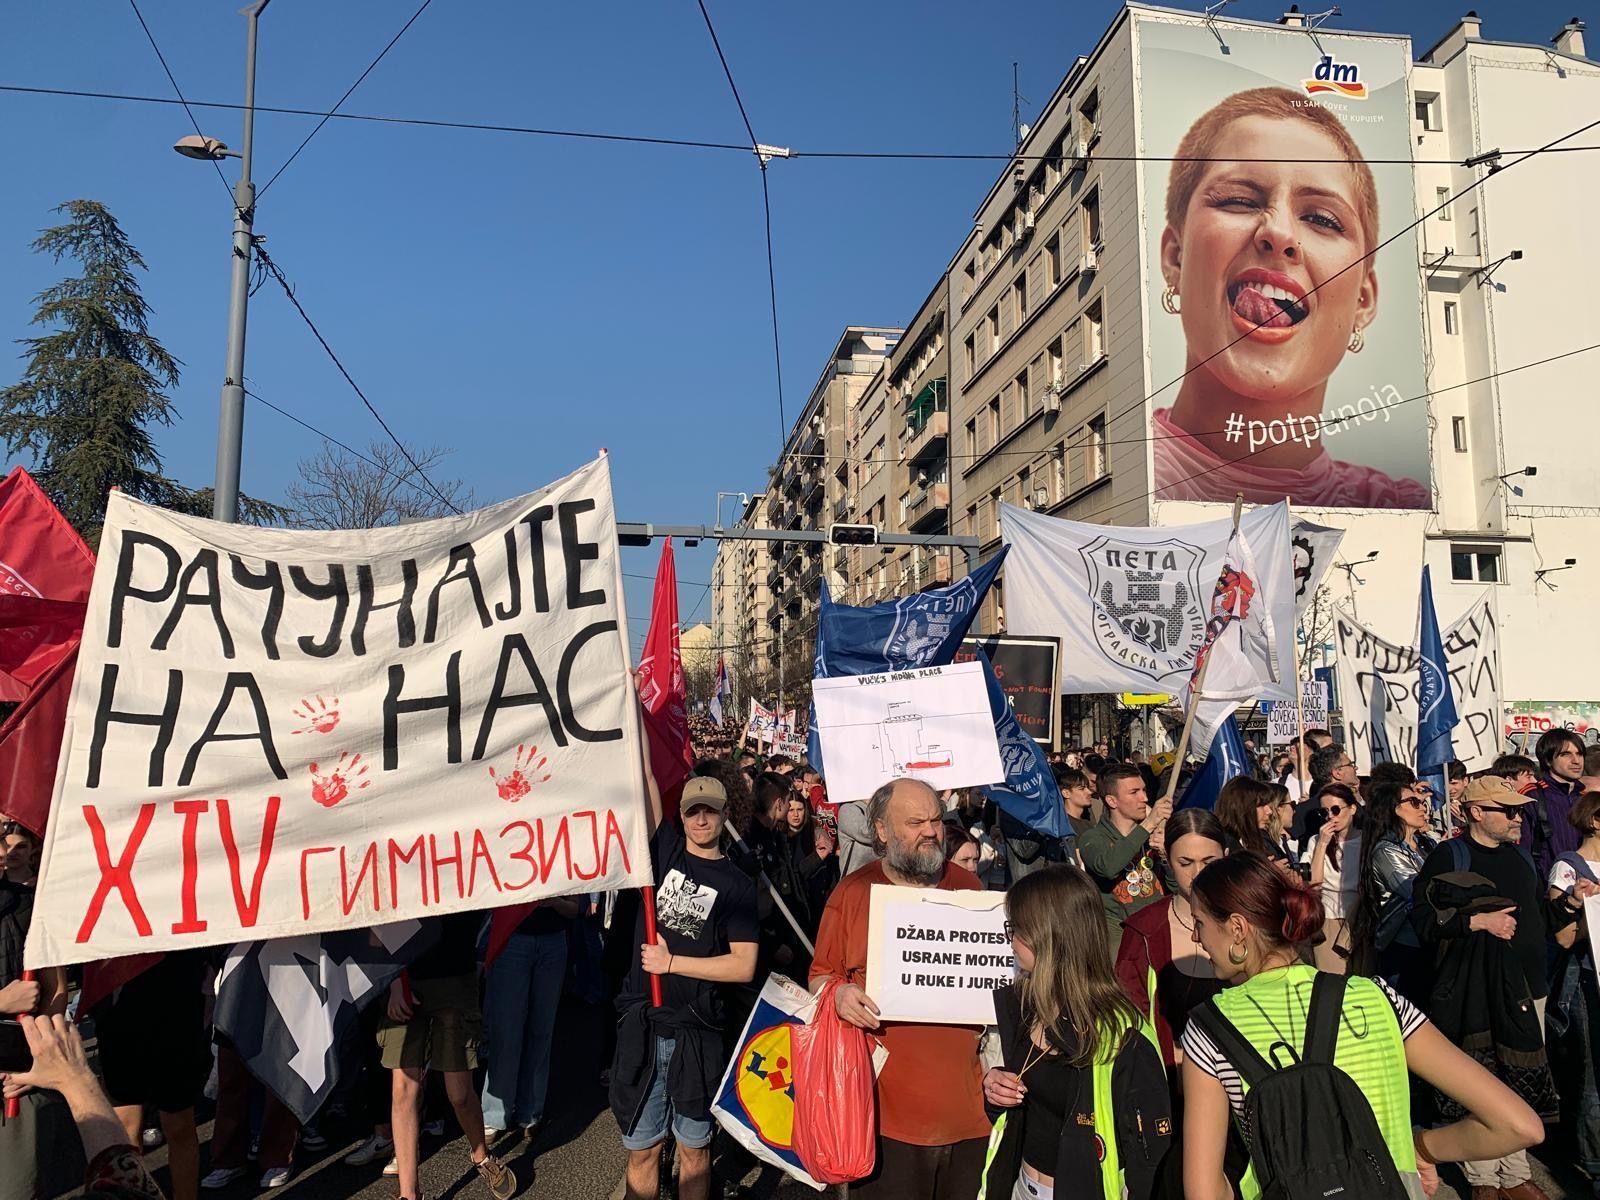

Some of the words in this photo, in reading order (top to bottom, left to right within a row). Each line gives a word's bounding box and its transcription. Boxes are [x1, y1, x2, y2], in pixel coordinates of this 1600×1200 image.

[1314, 57, 1358, 83] dm
[1290, 100, 1301, 108] TU
[1303, 100, 1320, 108] SAM
[1337, 113, 1348, 121] TU
[1223, 381, 1403, 453] #potpunoja
[107, 498, 607, 660] РАЧУНАЈТЕ
[919, 667, 943, 678] PLACE
[87, 663, 288, 789] НА
[383, 620, 624, 771] НАС
[75, 796, 281, 943] XIV
[301, 809, 631, 921] ГИМНАЗИЈА
[896, 924, 946, 942] DŽABA
[902, 950, 962, 965] USRANE
[965, 954, 1015, 968] MOTKE
[901, 973, 911, 986] U
[915, 974, 955, 988] RUKE
[958, 976, 964, 988] I
